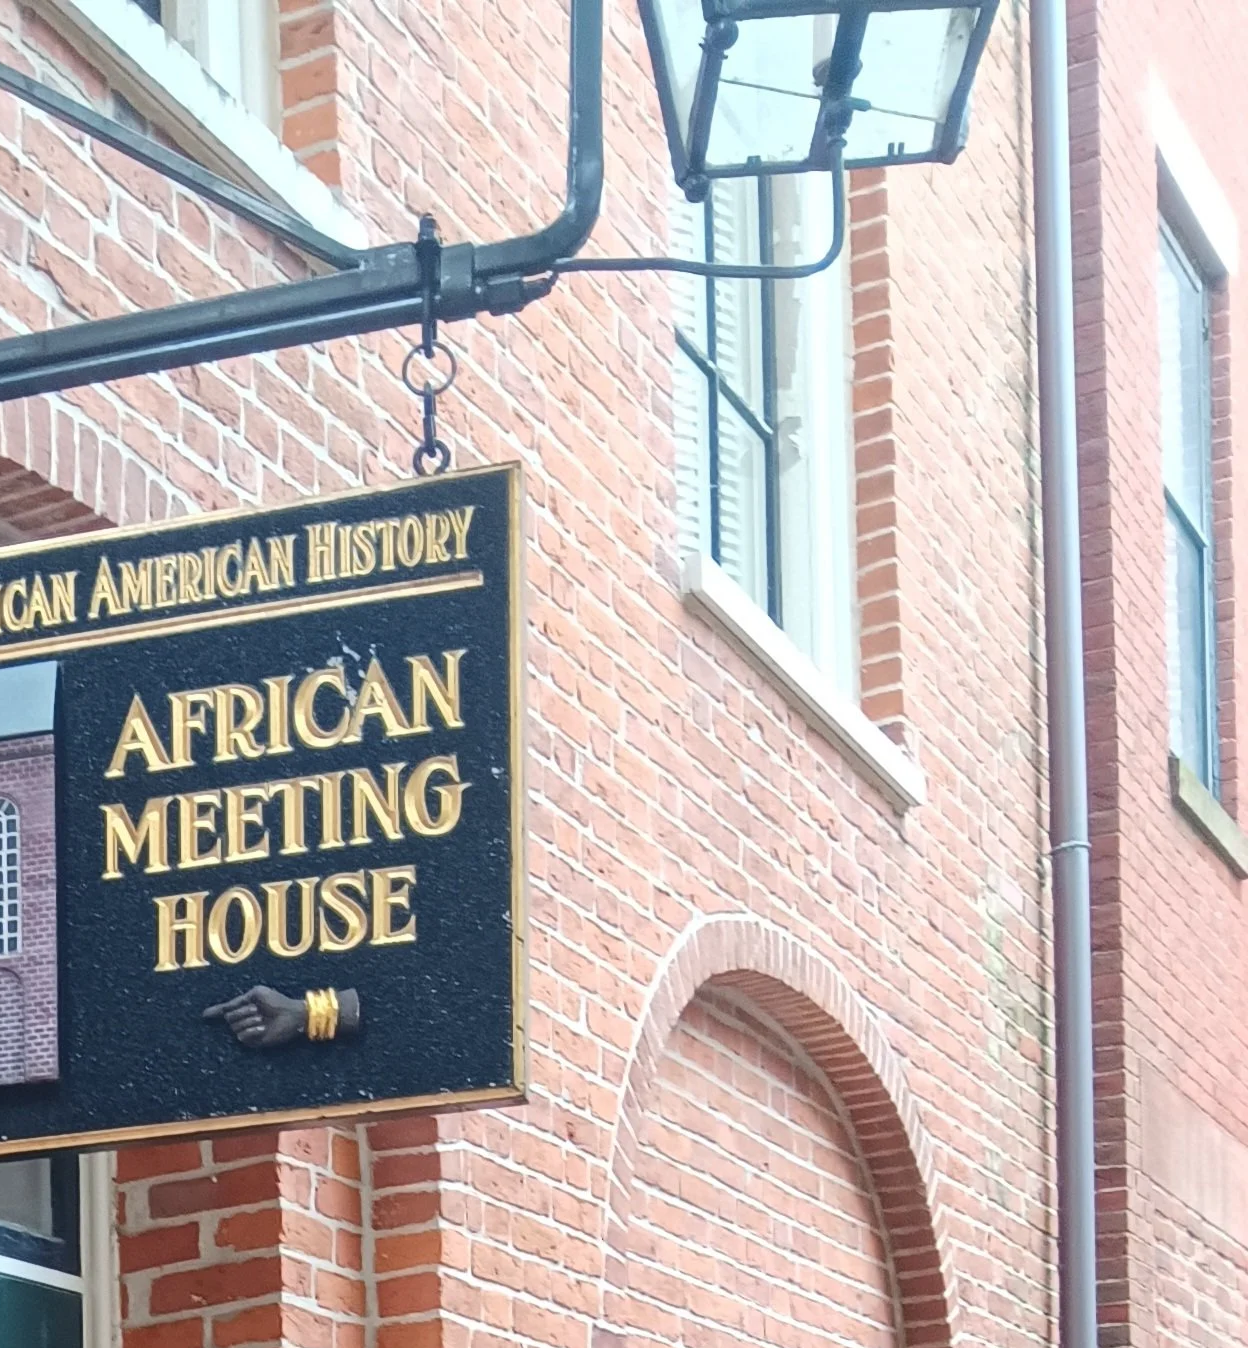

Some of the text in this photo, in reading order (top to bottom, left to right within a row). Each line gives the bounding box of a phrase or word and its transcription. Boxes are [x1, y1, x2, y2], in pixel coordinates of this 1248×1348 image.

[88, 534, 297, 619] AMERICAN
[305, 505, 475, 583] HISTORY
[103, 649, 469, 779] AFRICAN
[98, 753, 473, 880] MEETING
[153, 865, 417, 972] HOUSE
